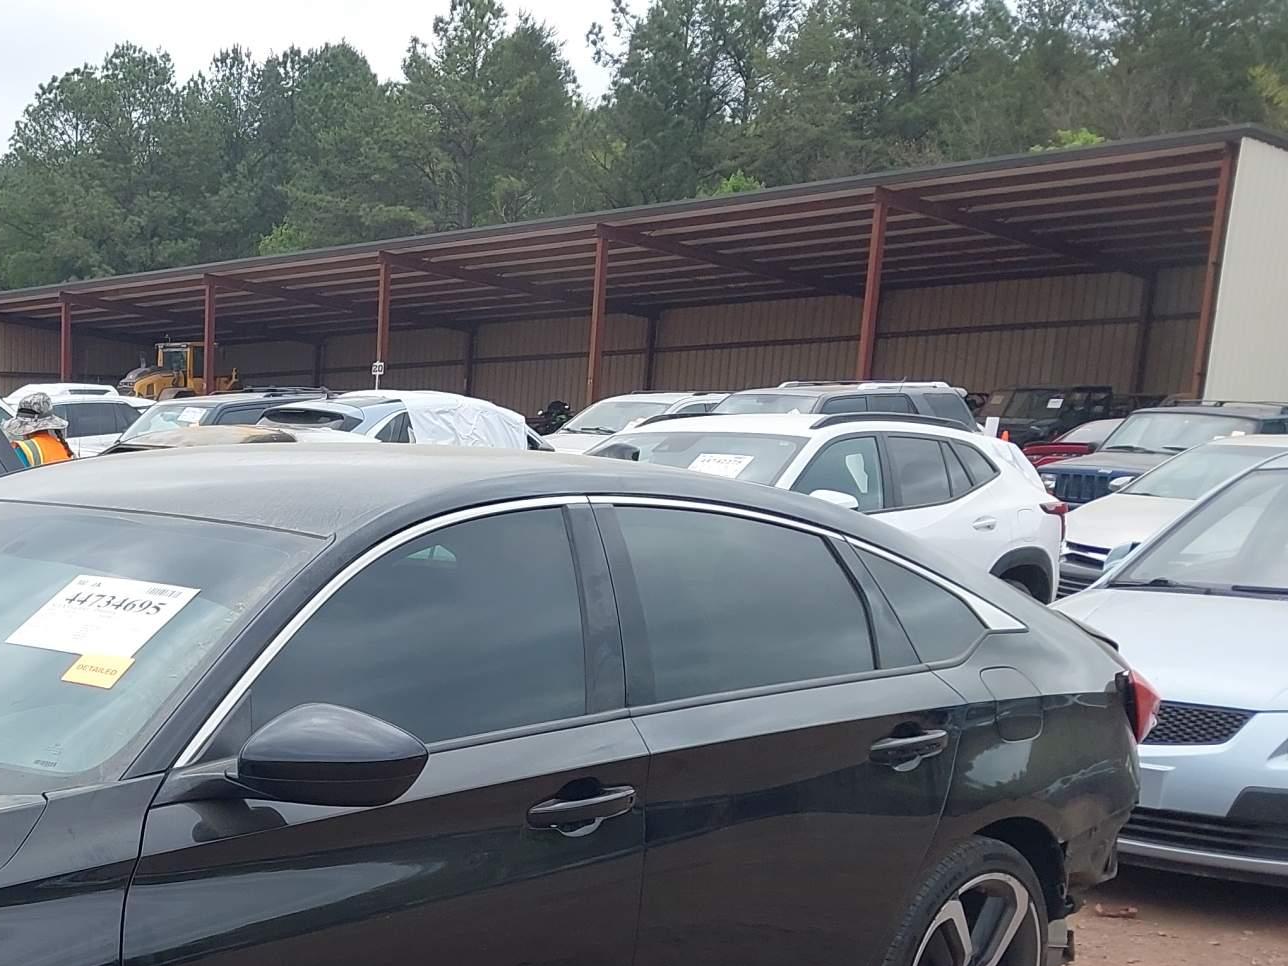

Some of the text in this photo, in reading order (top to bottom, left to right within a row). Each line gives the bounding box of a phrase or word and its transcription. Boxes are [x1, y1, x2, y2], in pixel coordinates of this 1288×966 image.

[372, 364, 383, 373] 20
[65, 591, 168, 616] 44734695
[75, 663, 119, 677] DETAILED
